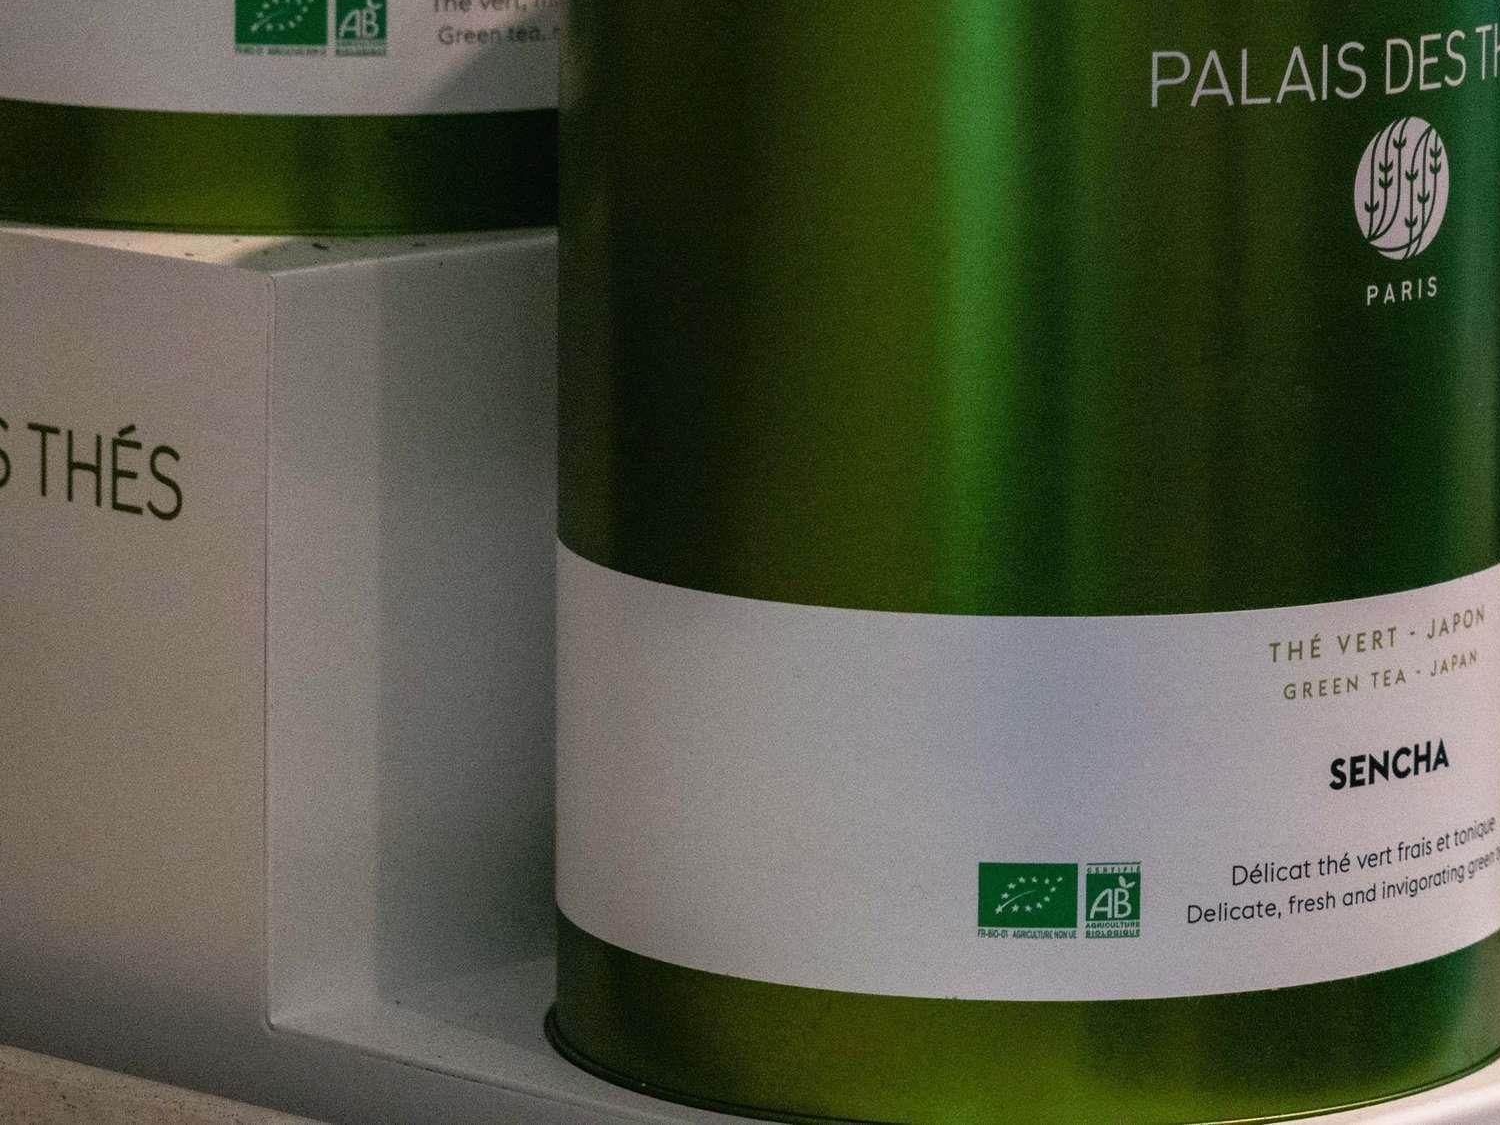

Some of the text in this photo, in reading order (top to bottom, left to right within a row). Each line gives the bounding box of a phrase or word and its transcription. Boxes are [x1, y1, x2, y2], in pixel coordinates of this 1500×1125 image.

[438, 25, 500, 45] Green
[1151, 41, 1367, 108] PALAIS
[1385, 29, 1467, 96] DES
[1366, 276, 1438, 306] PARIS
[28, 423, 183, 520] THÉS
[1269, 633, 1321, 663] THÉ
[1337, 627, 1398, 654] VERT
[1427, 604, 1486, 640] JAPON
[1283, 675, 1359, 701] GREEN
[1371, 670, 1407, 689] TEA
[1430, 649, 1478, 677] JAPAN
[1329, 738, 1449, 791] SENCHA
[1232, 859, 1311, 886] Délicat
[1318, 852, 1350, 874] thé
[1356, 846, 1392, 870] vert
[1397, 837, 1433, 862] frais
[1436, 832, 1451, 852] et
[1089, 887, 1132, 920] AB
[1187, 896, 1282, 924] Delicate,
[1288, 890, 1336, 915] fresh
[1342, 884, 1376, 906] and
[1381, 864, 1465, 899] invigorating
